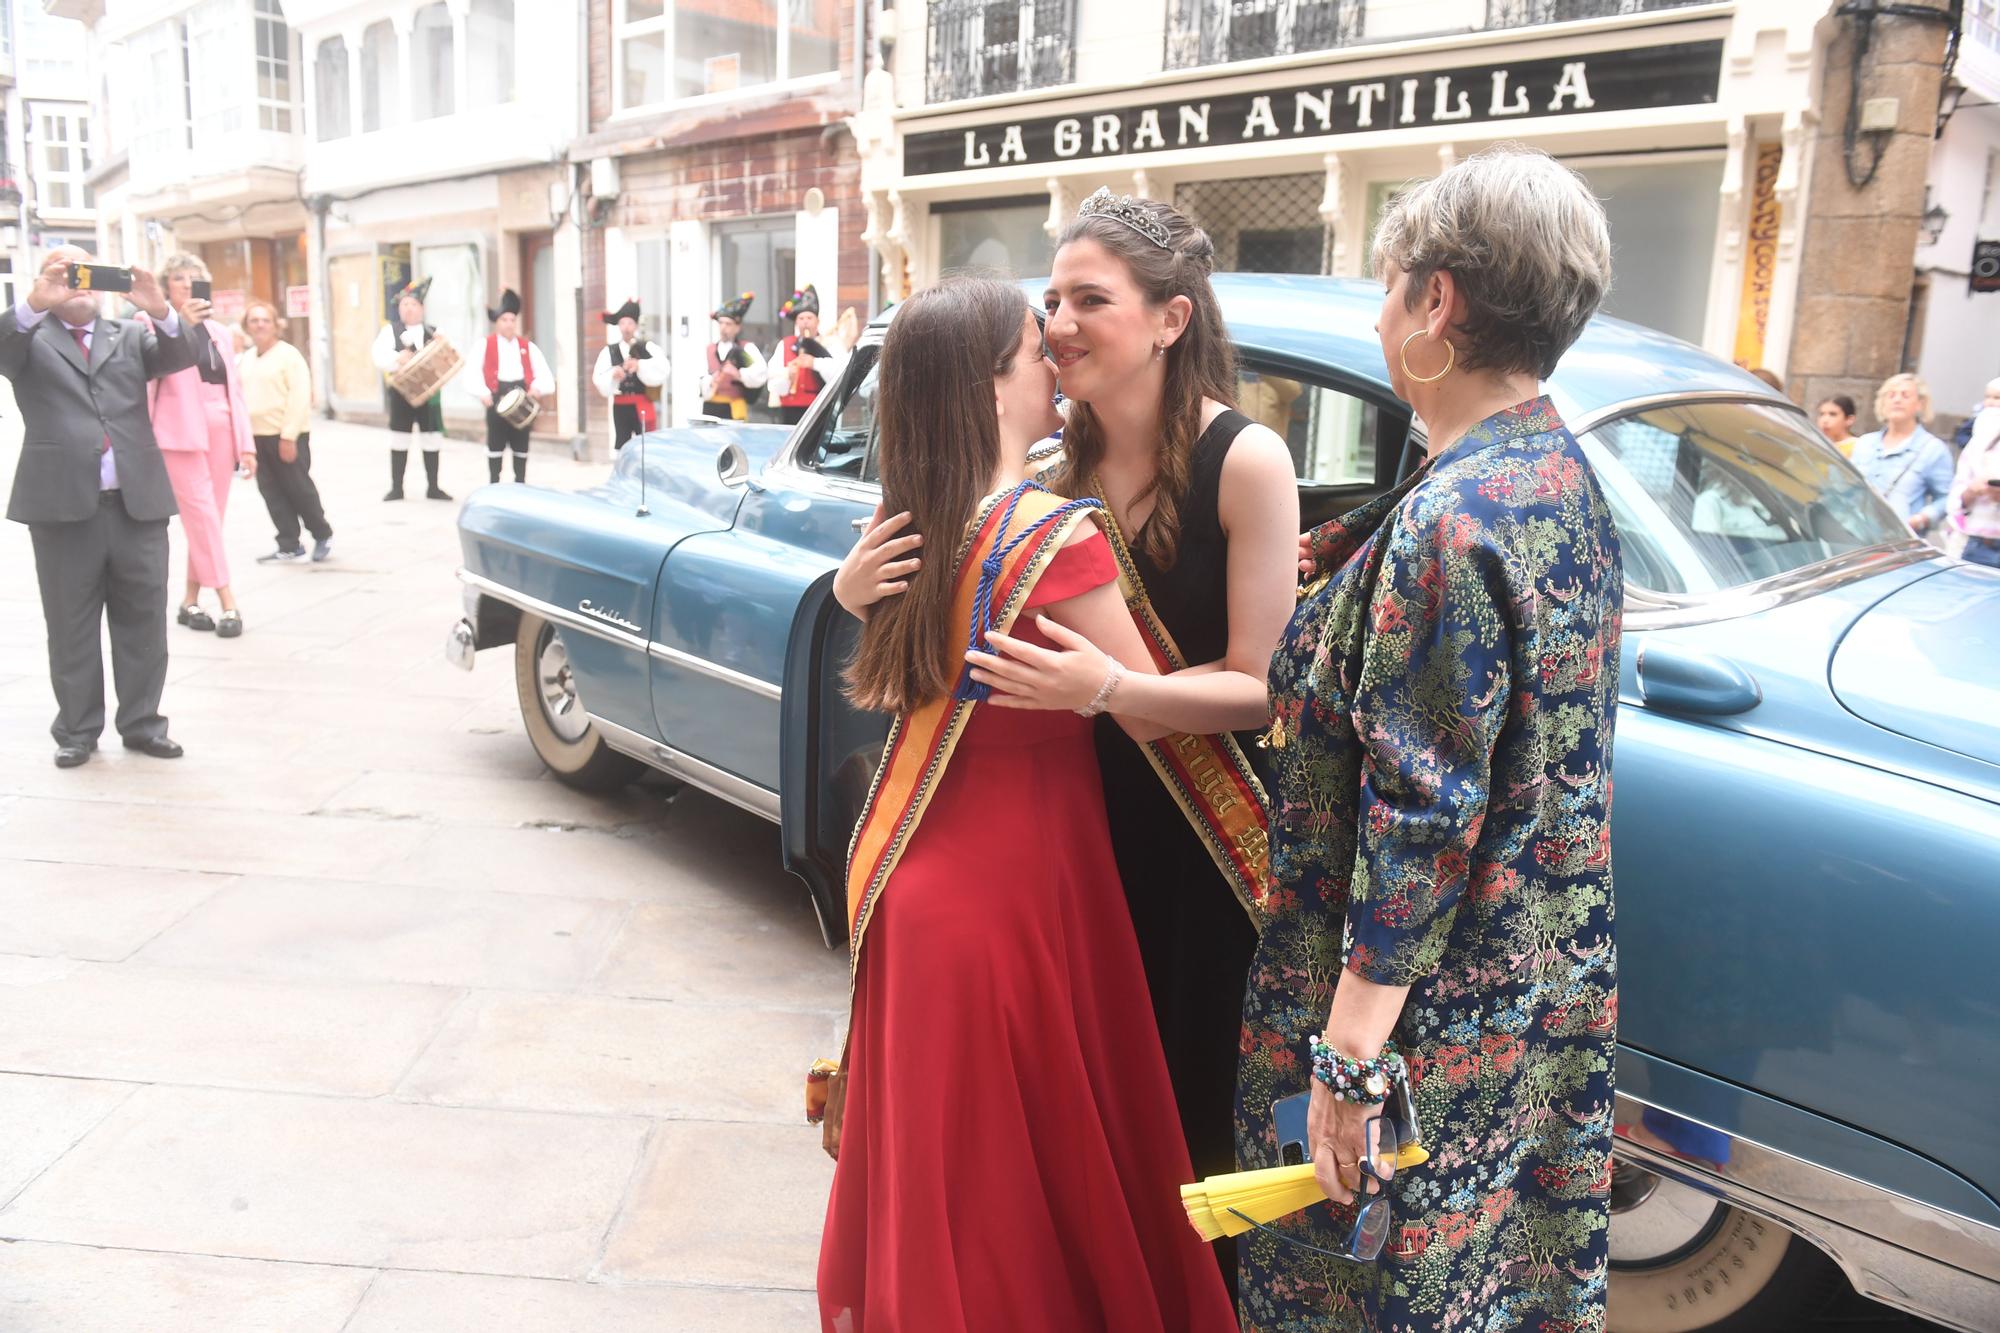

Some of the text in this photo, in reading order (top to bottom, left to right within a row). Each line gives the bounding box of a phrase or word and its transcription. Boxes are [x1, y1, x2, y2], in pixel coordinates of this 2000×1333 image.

[963, 61, 1596, 167] LA GRAN ANTILLA
[1176, 731, 1239, 816] eiga
